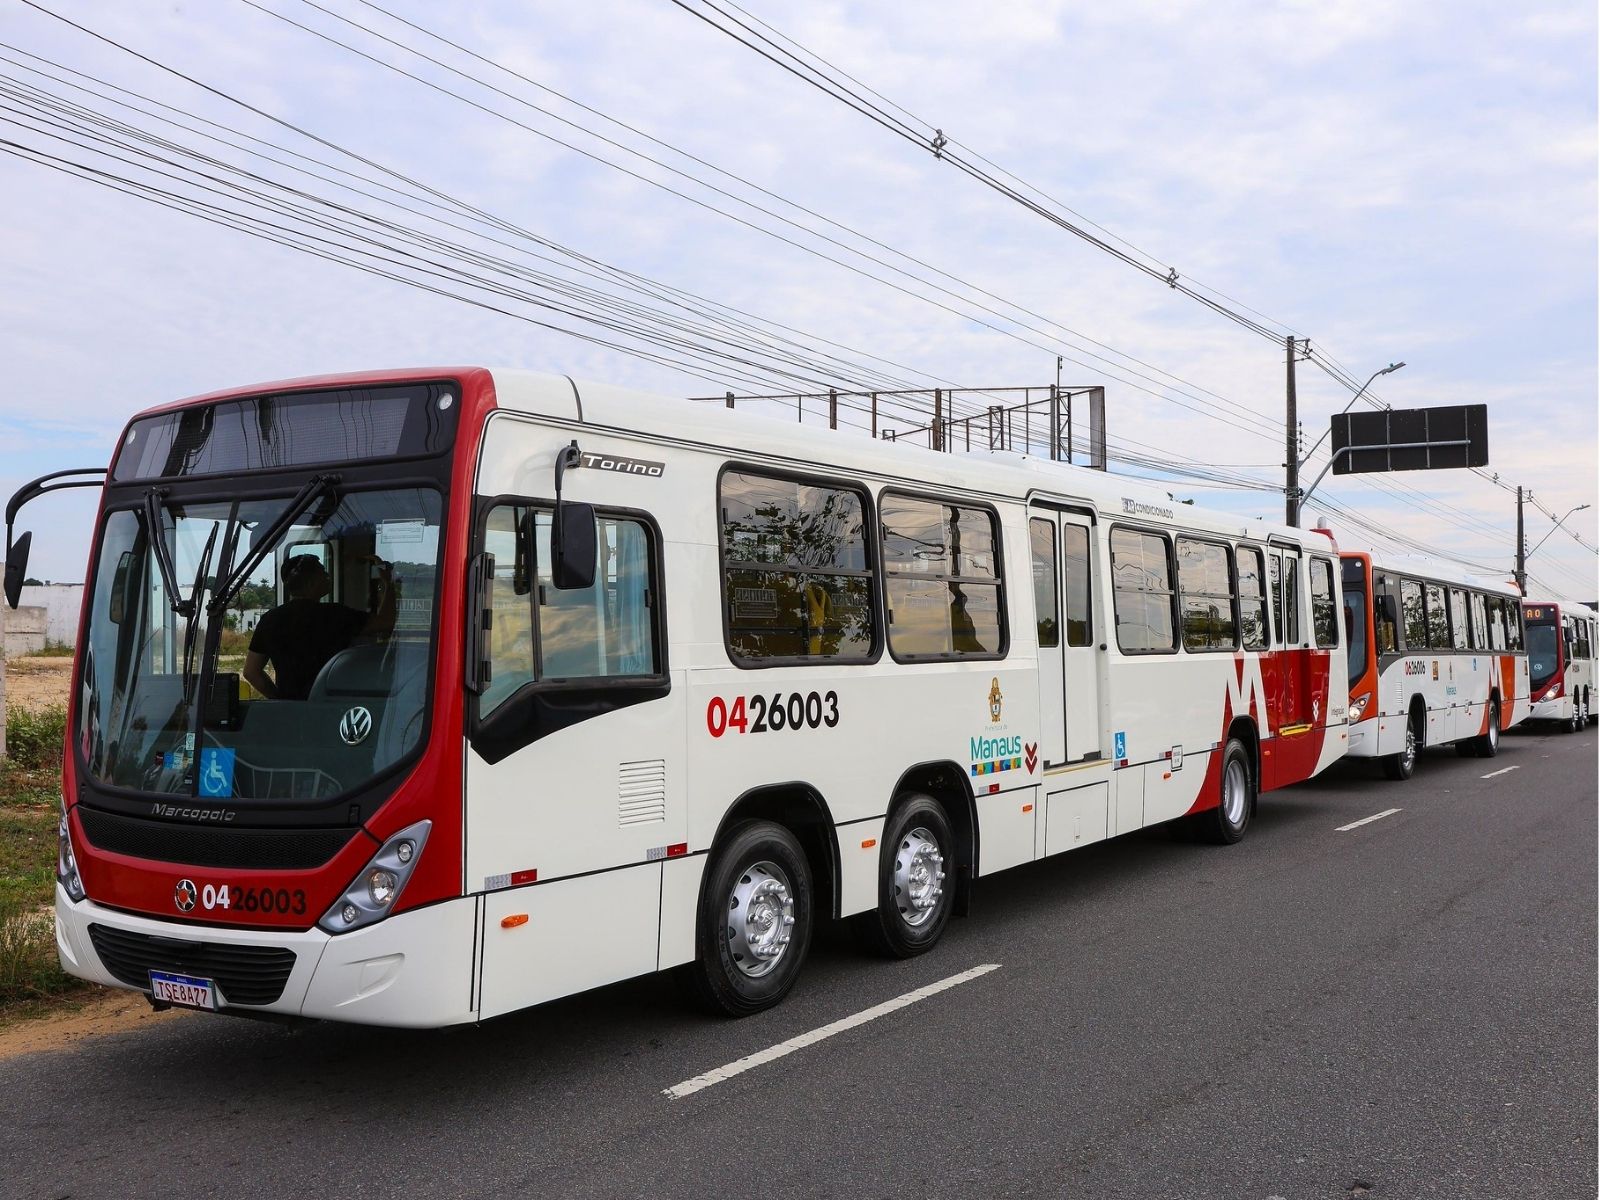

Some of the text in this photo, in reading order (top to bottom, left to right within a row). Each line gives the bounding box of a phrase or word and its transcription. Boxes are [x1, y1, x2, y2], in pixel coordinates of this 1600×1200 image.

[583, 455, 662, 476] Torino
[707, 690, 840, 738] 0426003
[970, 735, 1021, 761] Manaus
[151, 803, 236, 821] Marcopolo
[202, 884, 306, 915] 0426003
